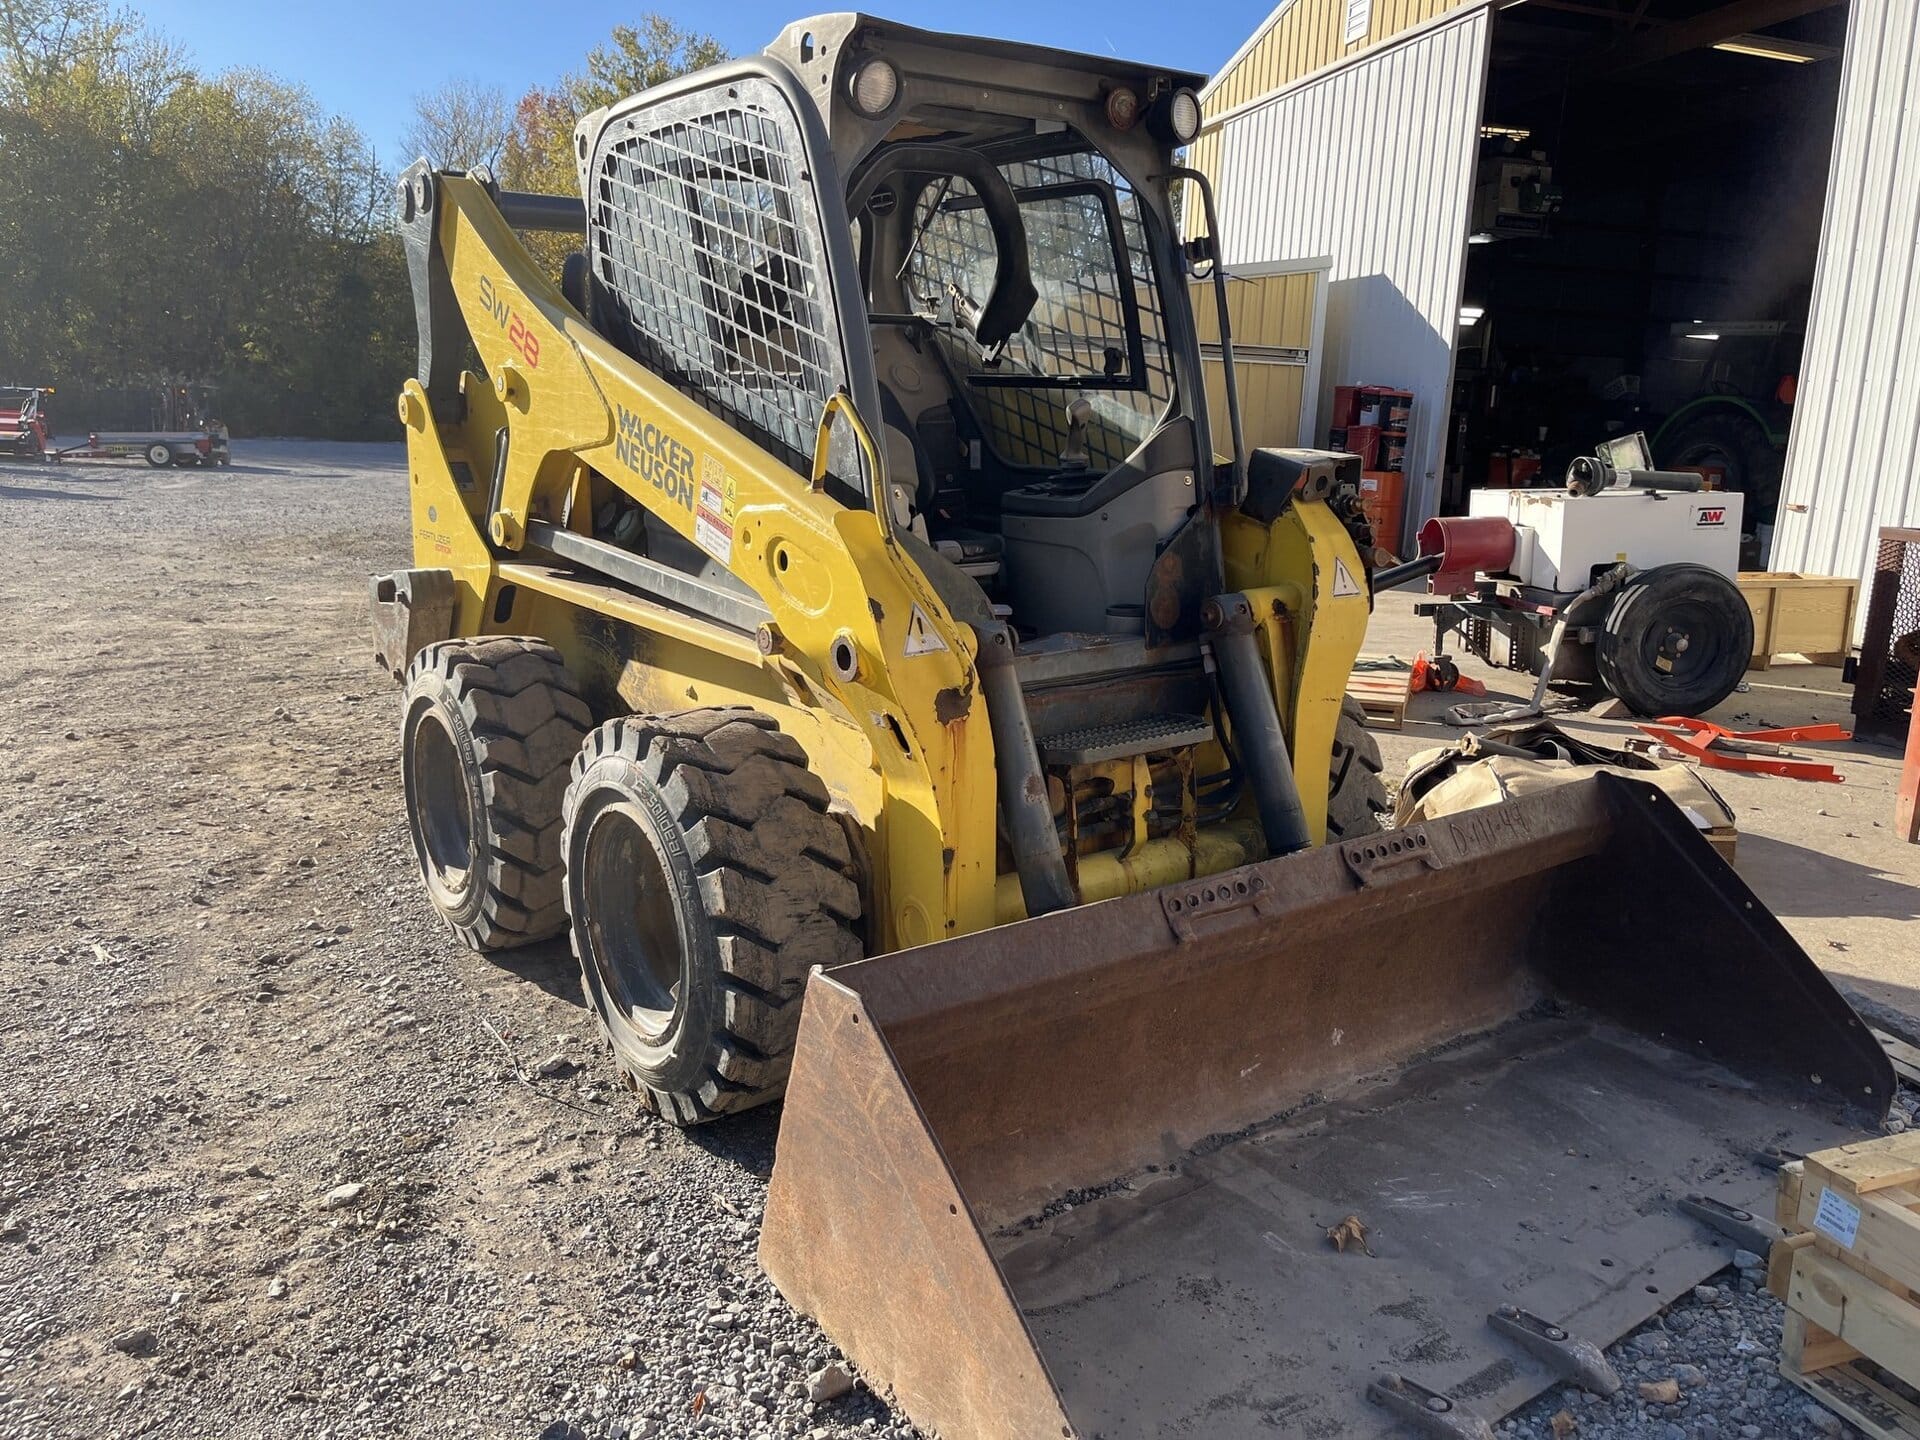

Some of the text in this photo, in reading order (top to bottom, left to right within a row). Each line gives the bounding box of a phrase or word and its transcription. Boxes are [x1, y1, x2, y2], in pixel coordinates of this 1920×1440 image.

[616, 432, 694, 513] NEUSON
[617, 403, 694, 482] WACKER
[1699, 511, 1723, 522] AW
[453, 714, 475, 765] solideal
[647, 793, 684, 857] solideal
